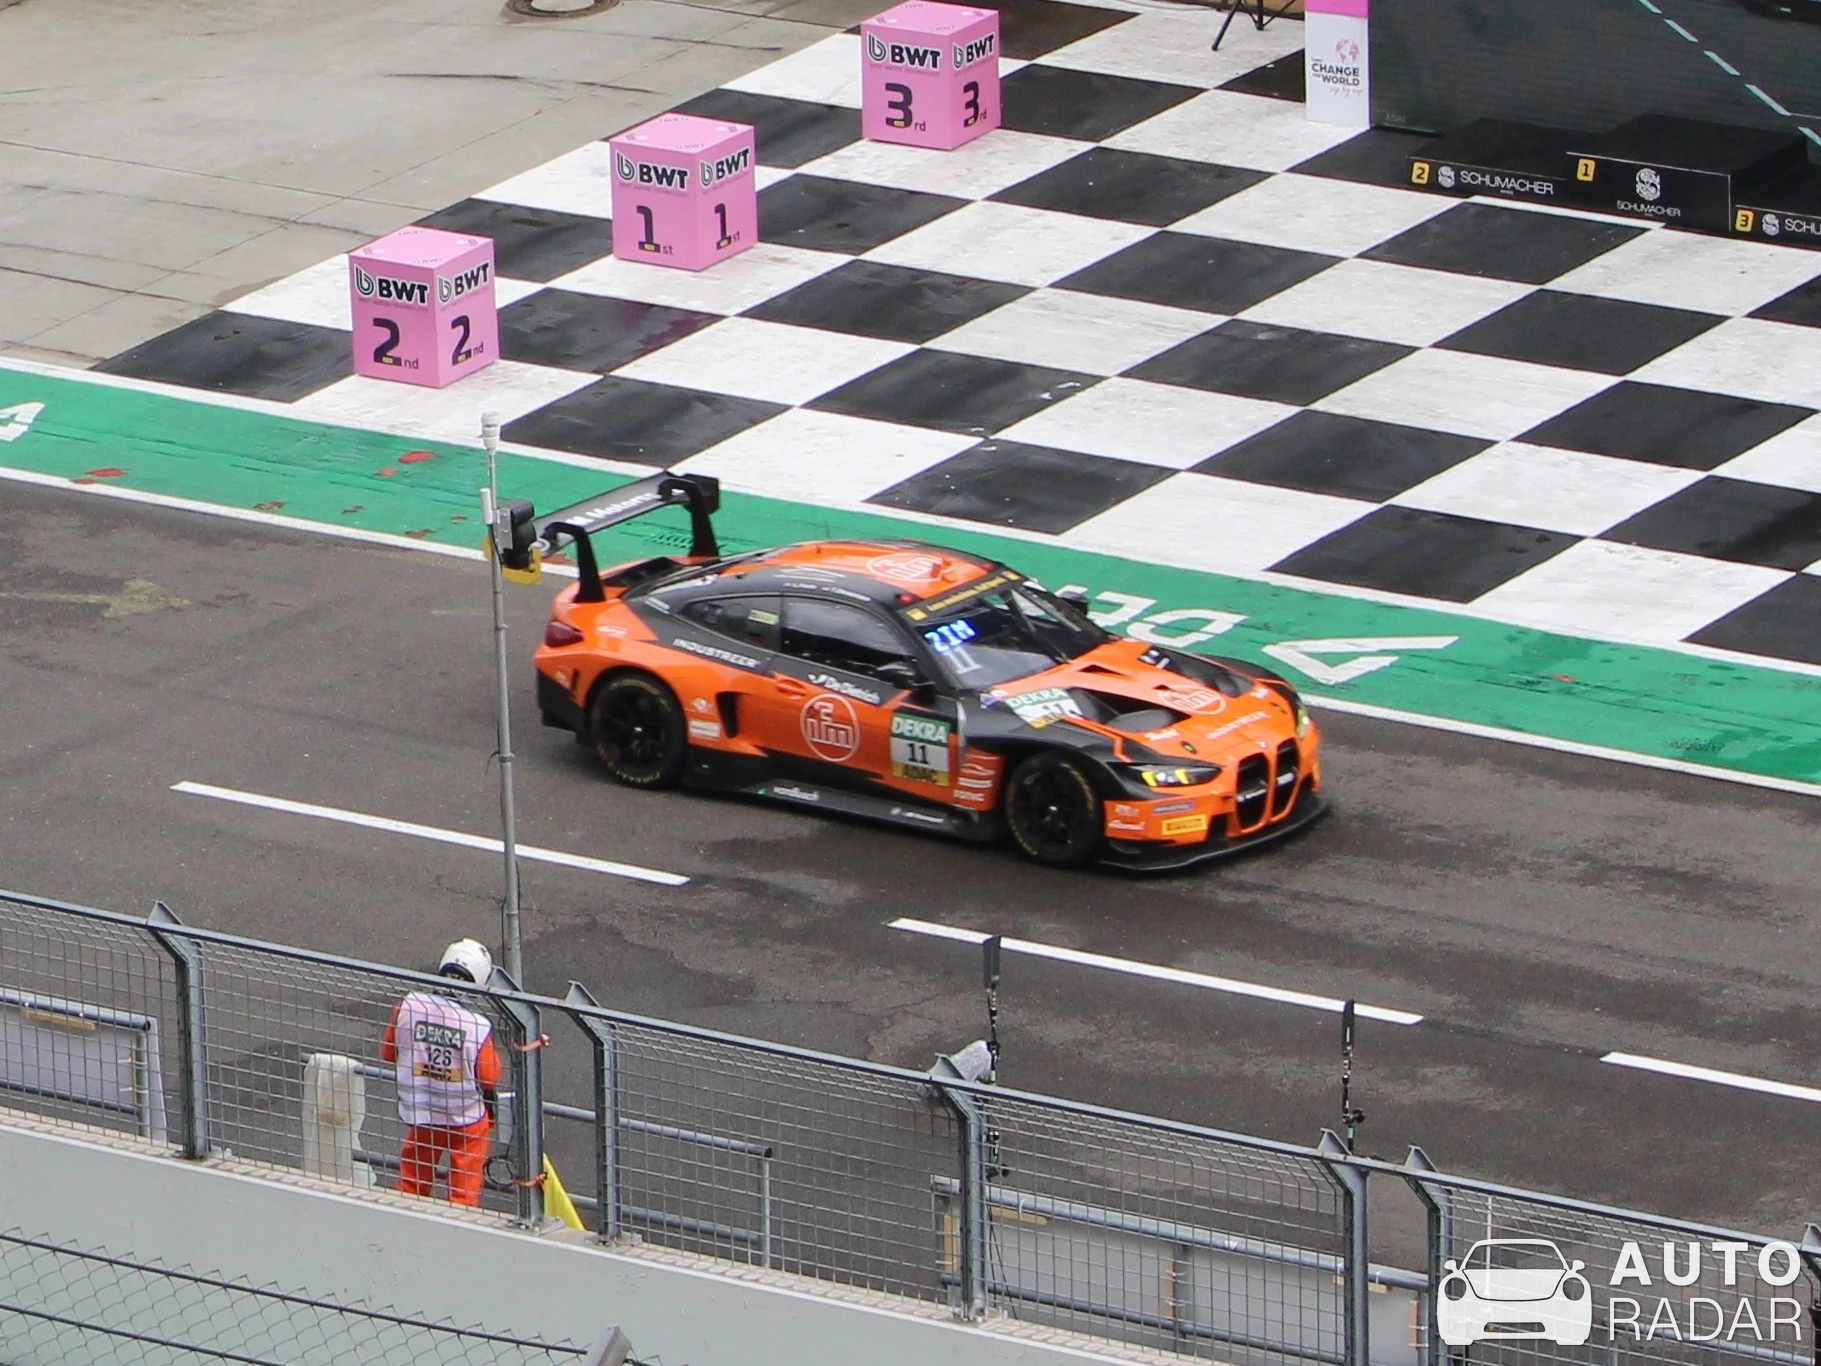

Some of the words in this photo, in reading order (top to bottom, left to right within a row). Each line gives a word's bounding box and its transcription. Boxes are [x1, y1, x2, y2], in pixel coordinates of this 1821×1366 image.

[890, 44, 940, 69] BWT
[966, 34, 994, 63] BWT
[1311, 62, 1360, 77] CHANGE
[1321, 74, 1360, 87] WORLD
[639, 164, 689, 190] BWT
[716, 148, 750, 181] BWT
[1460, 170, 1554, 195] SCHUMACHER
[1616, 200, 1681, 218] SCHUMACHER
[377, 277, 428, 304] BWT
[454, 262, 490, 297] BWT
[1004, 687, 1070, 709] DEKRA
[890, 715, 948, 744] DEKRA
[907, 743, 929, 765] 11
